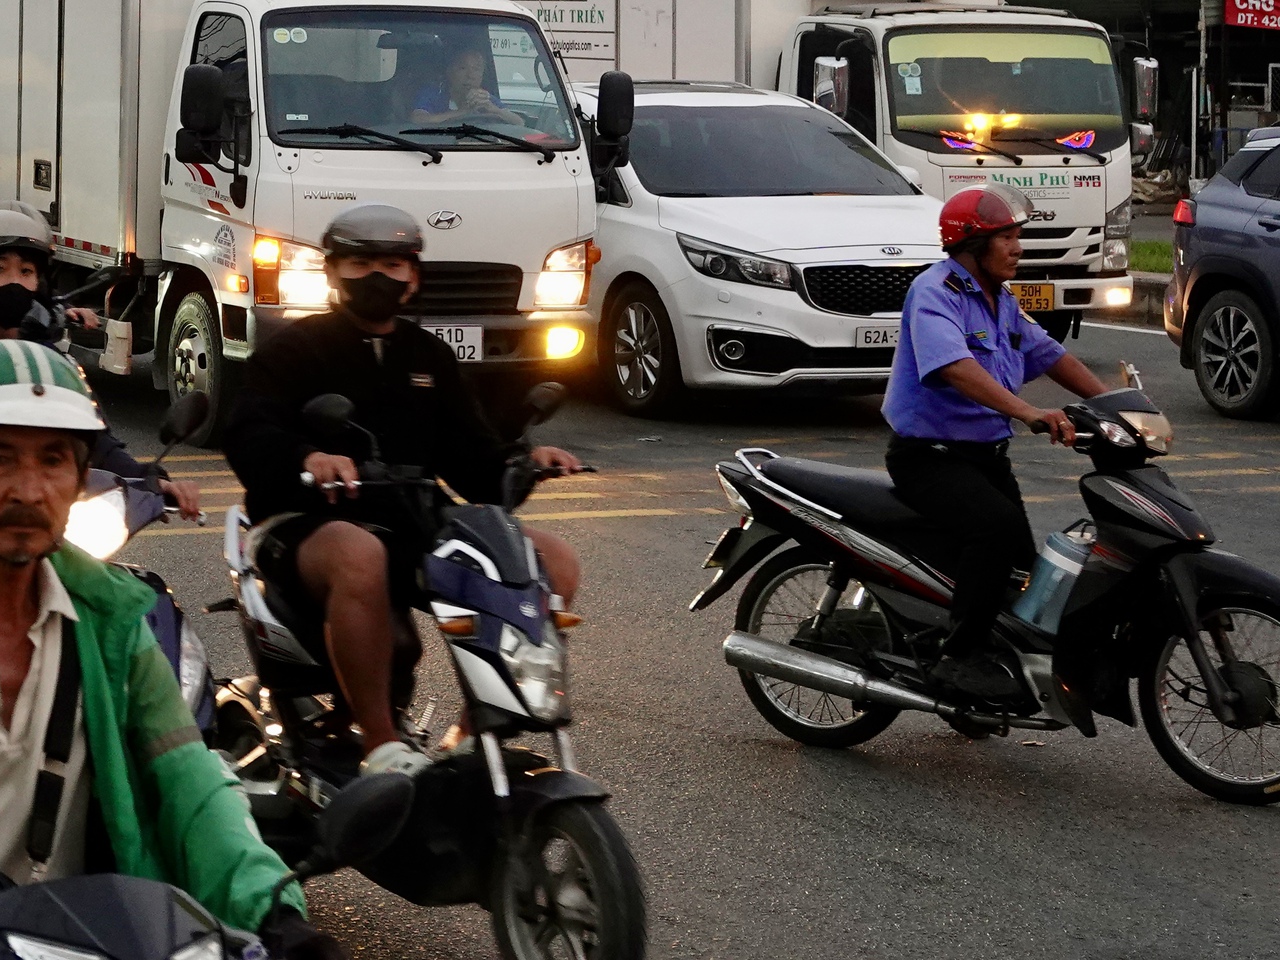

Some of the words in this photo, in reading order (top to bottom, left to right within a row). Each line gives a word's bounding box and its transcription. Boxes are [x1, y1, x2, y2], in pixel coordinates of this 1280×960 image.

[538, 5, 565, 23] PHÁT
[1039, 171, 1070, 186] PHÚ
[303, 190, 357, 201] HYUNDAI
[1020, 285, 1041, 297] 50H
[435, 328, 464, 343] 51D
